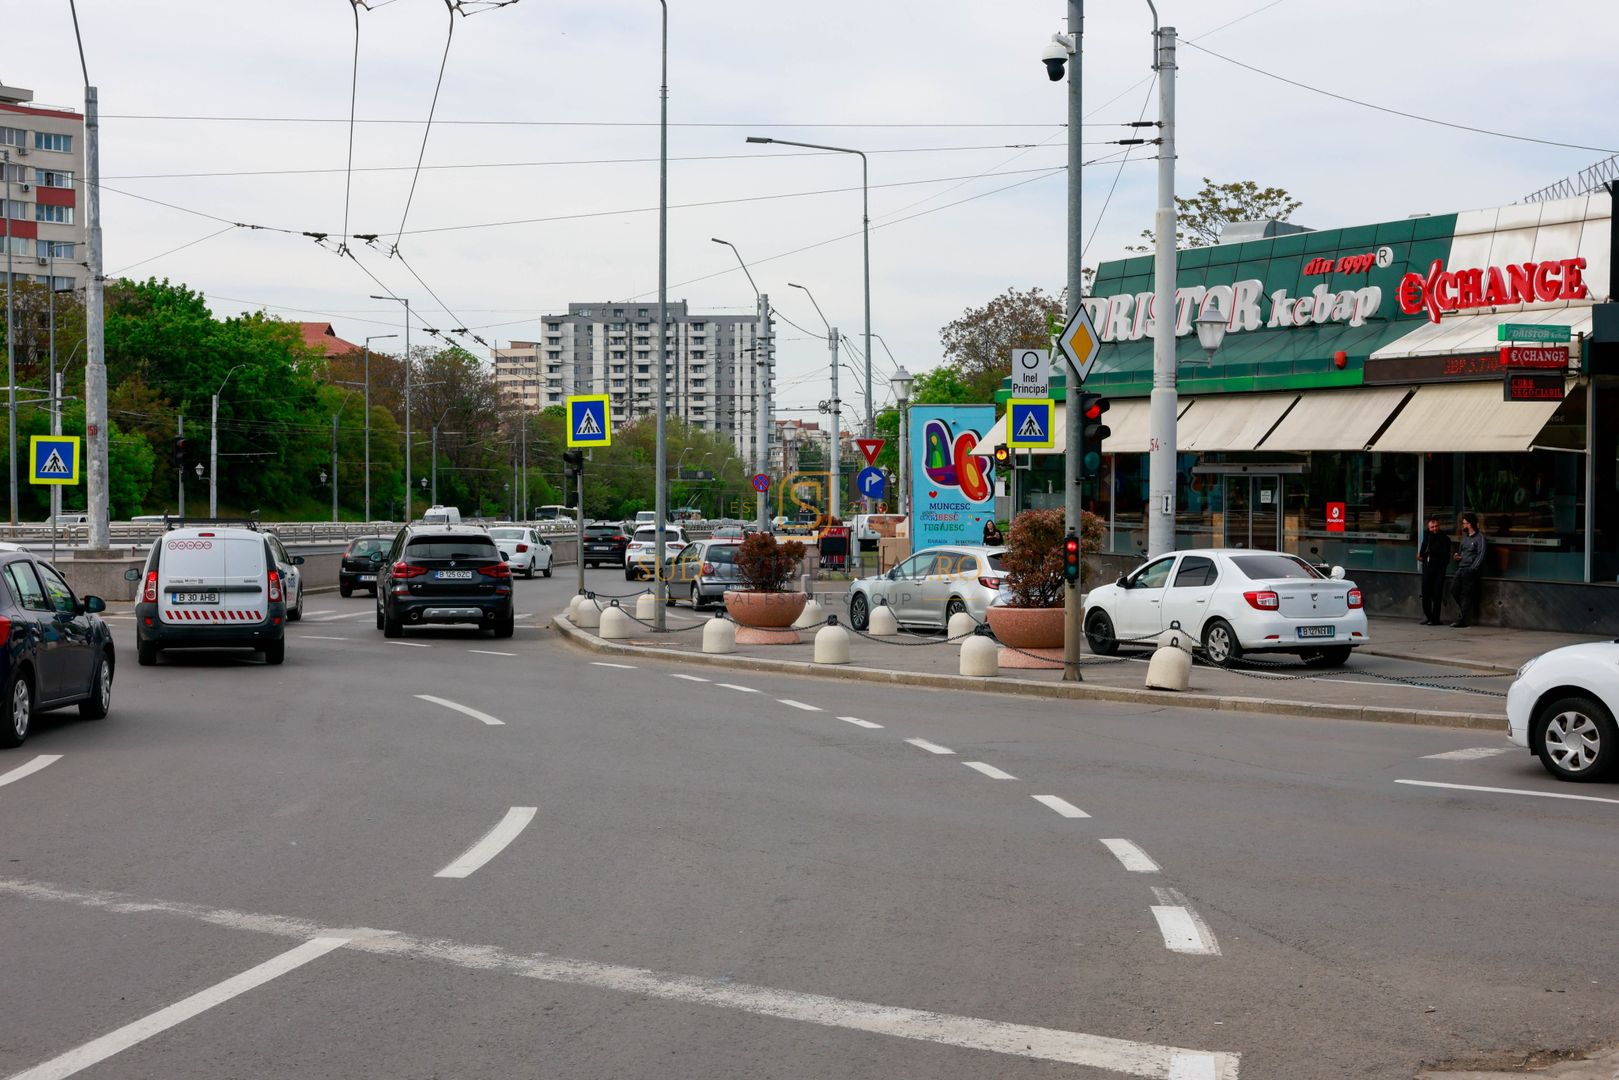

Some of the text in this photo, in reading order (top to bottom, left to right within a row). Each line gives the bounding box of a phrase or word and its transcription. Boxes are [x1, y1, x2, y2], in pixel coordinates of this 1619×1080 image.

[1303, 257, 1333, 276] din
[1335, 252, 1376, 275] 1999
[1267, 284, 1382, 328] kebap
[1023, 373, 1038, 383] Inel
[1013, 383, 1047, 396] Principal
[929, 502, 971, 511] MUNCESC
[439, 571, 445, 579] B
[179, 594, 216, 602] B 30 AHB
